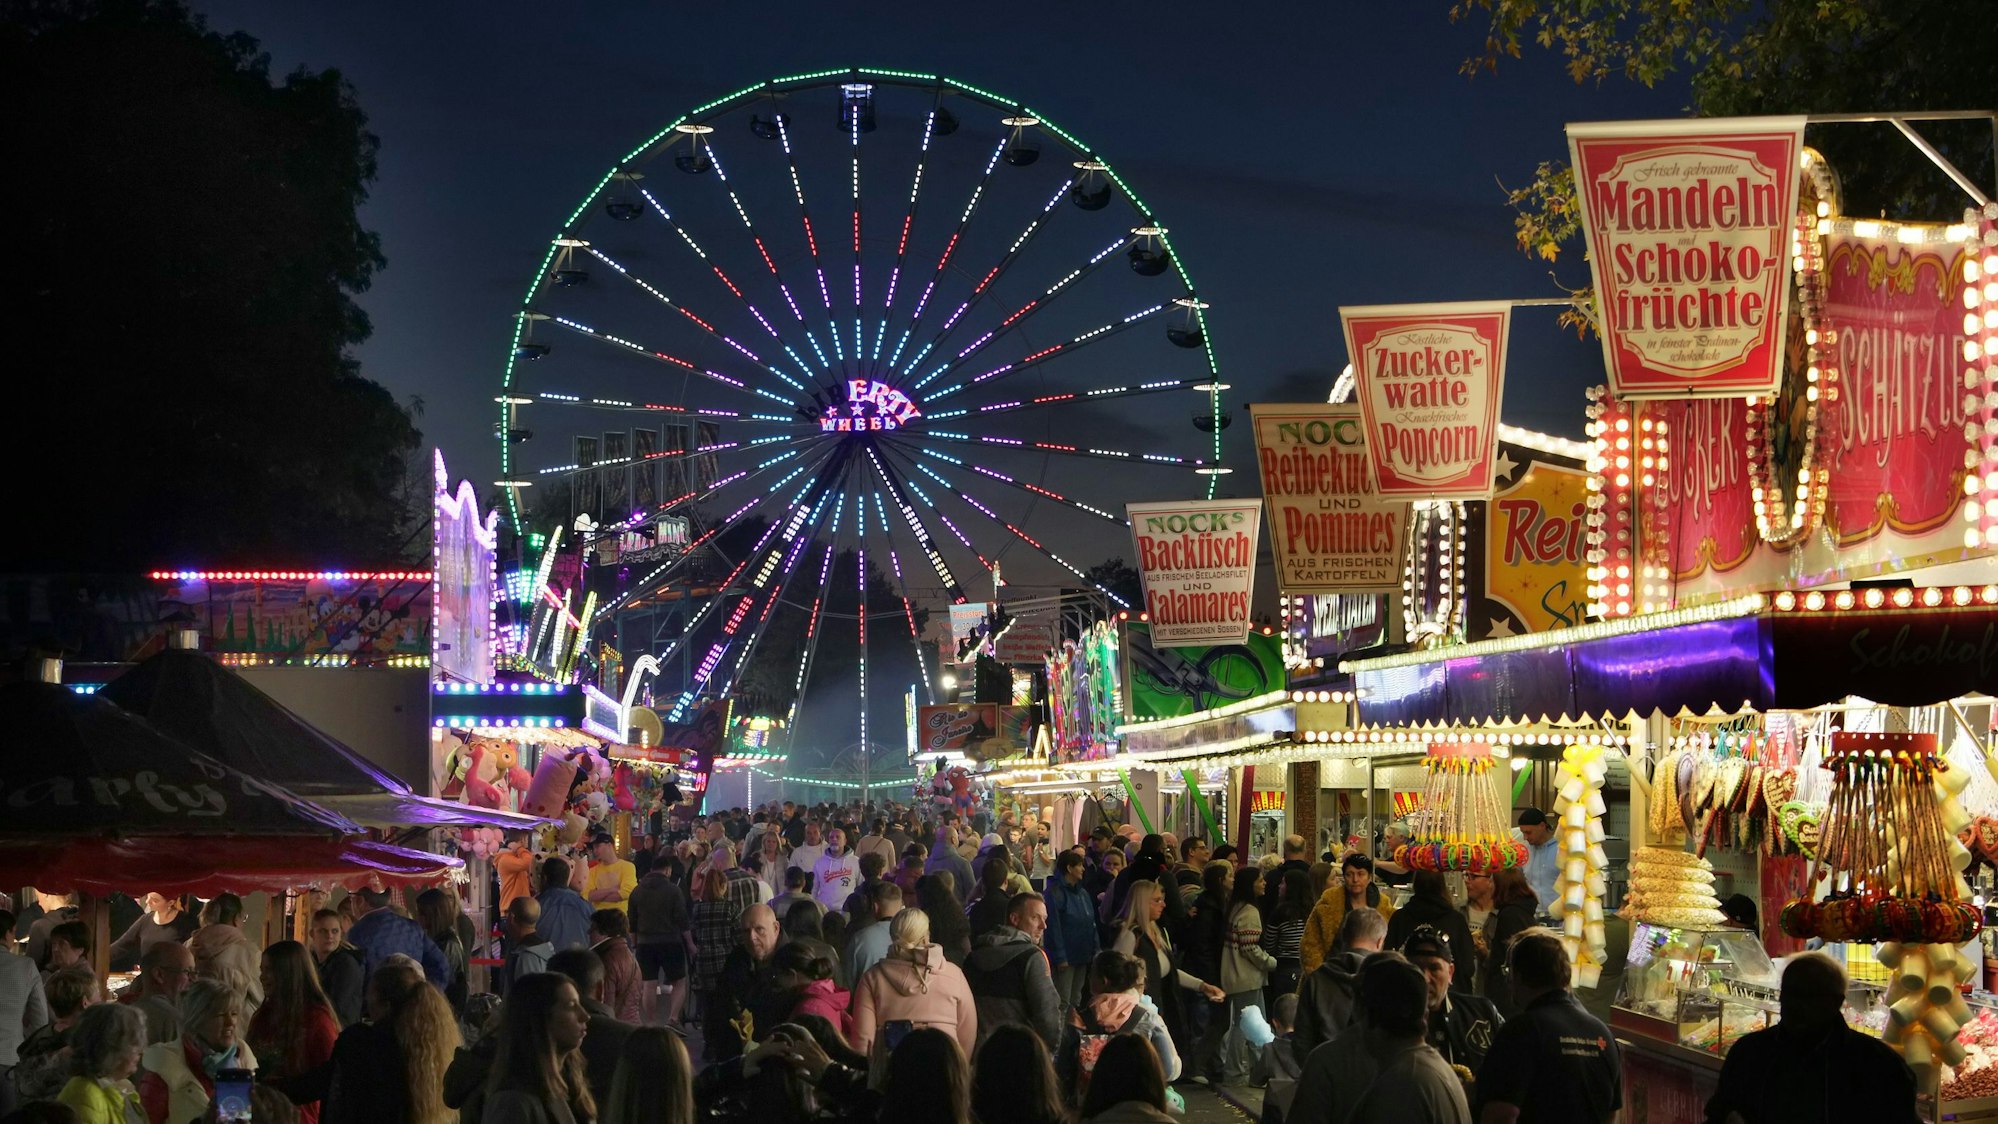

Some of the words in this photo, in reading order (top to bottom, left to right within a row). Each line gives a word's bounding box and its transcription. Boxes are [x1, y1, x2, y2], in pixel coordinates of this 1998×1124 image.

[1633, 161, 1680, 182] Frisch
[1683, 162, 1740, 181] gebrannte
[1597, 177, 1780, 232] Mandeln
[1677, 235, 1697, 246] und
[1615, 241, 1778, 285] Schoko-
[1617, 286, 1763, 331] früchte
[1397, 332, 1453, 346] Köstliche
[1646, 338, 1657, 348] in
[1658, 336, 1693, 353] feinster
[1375, 346, 1483, 378] Zucker-
[1668, 349, 1721, 363] schokolade
[1383, 377, 1467, 409] watte
[820, 417, 896, 431] WHEEL
[1395, 410, 1468, 426] Knackfrisches
[1277, 420, 1365, 446] NOC
[1380, 422, 1478, 473] Popcorn
[1260, 446, 1374, 496] Reibekuc
[1319, 498, 1361, 509] UND
[1283, 506, 1396, 555] Pommes
[1499, 499, 1597, 564] Rei
[1138, 531, 1249, 572] Backfisch
[1287, 559, 1316, 568] AUS
[1323, 557, 1393, 568] FRISCHEN
[1146, 574, 1160, 582] AUS
[1161, 572, 1195, 582] FRISCHEM
[1183, 582, 1212, 591] UND
[1294, 569, 1386, 581] KARTOFFELN
[1147, 588, 1248, 626] Calamares
